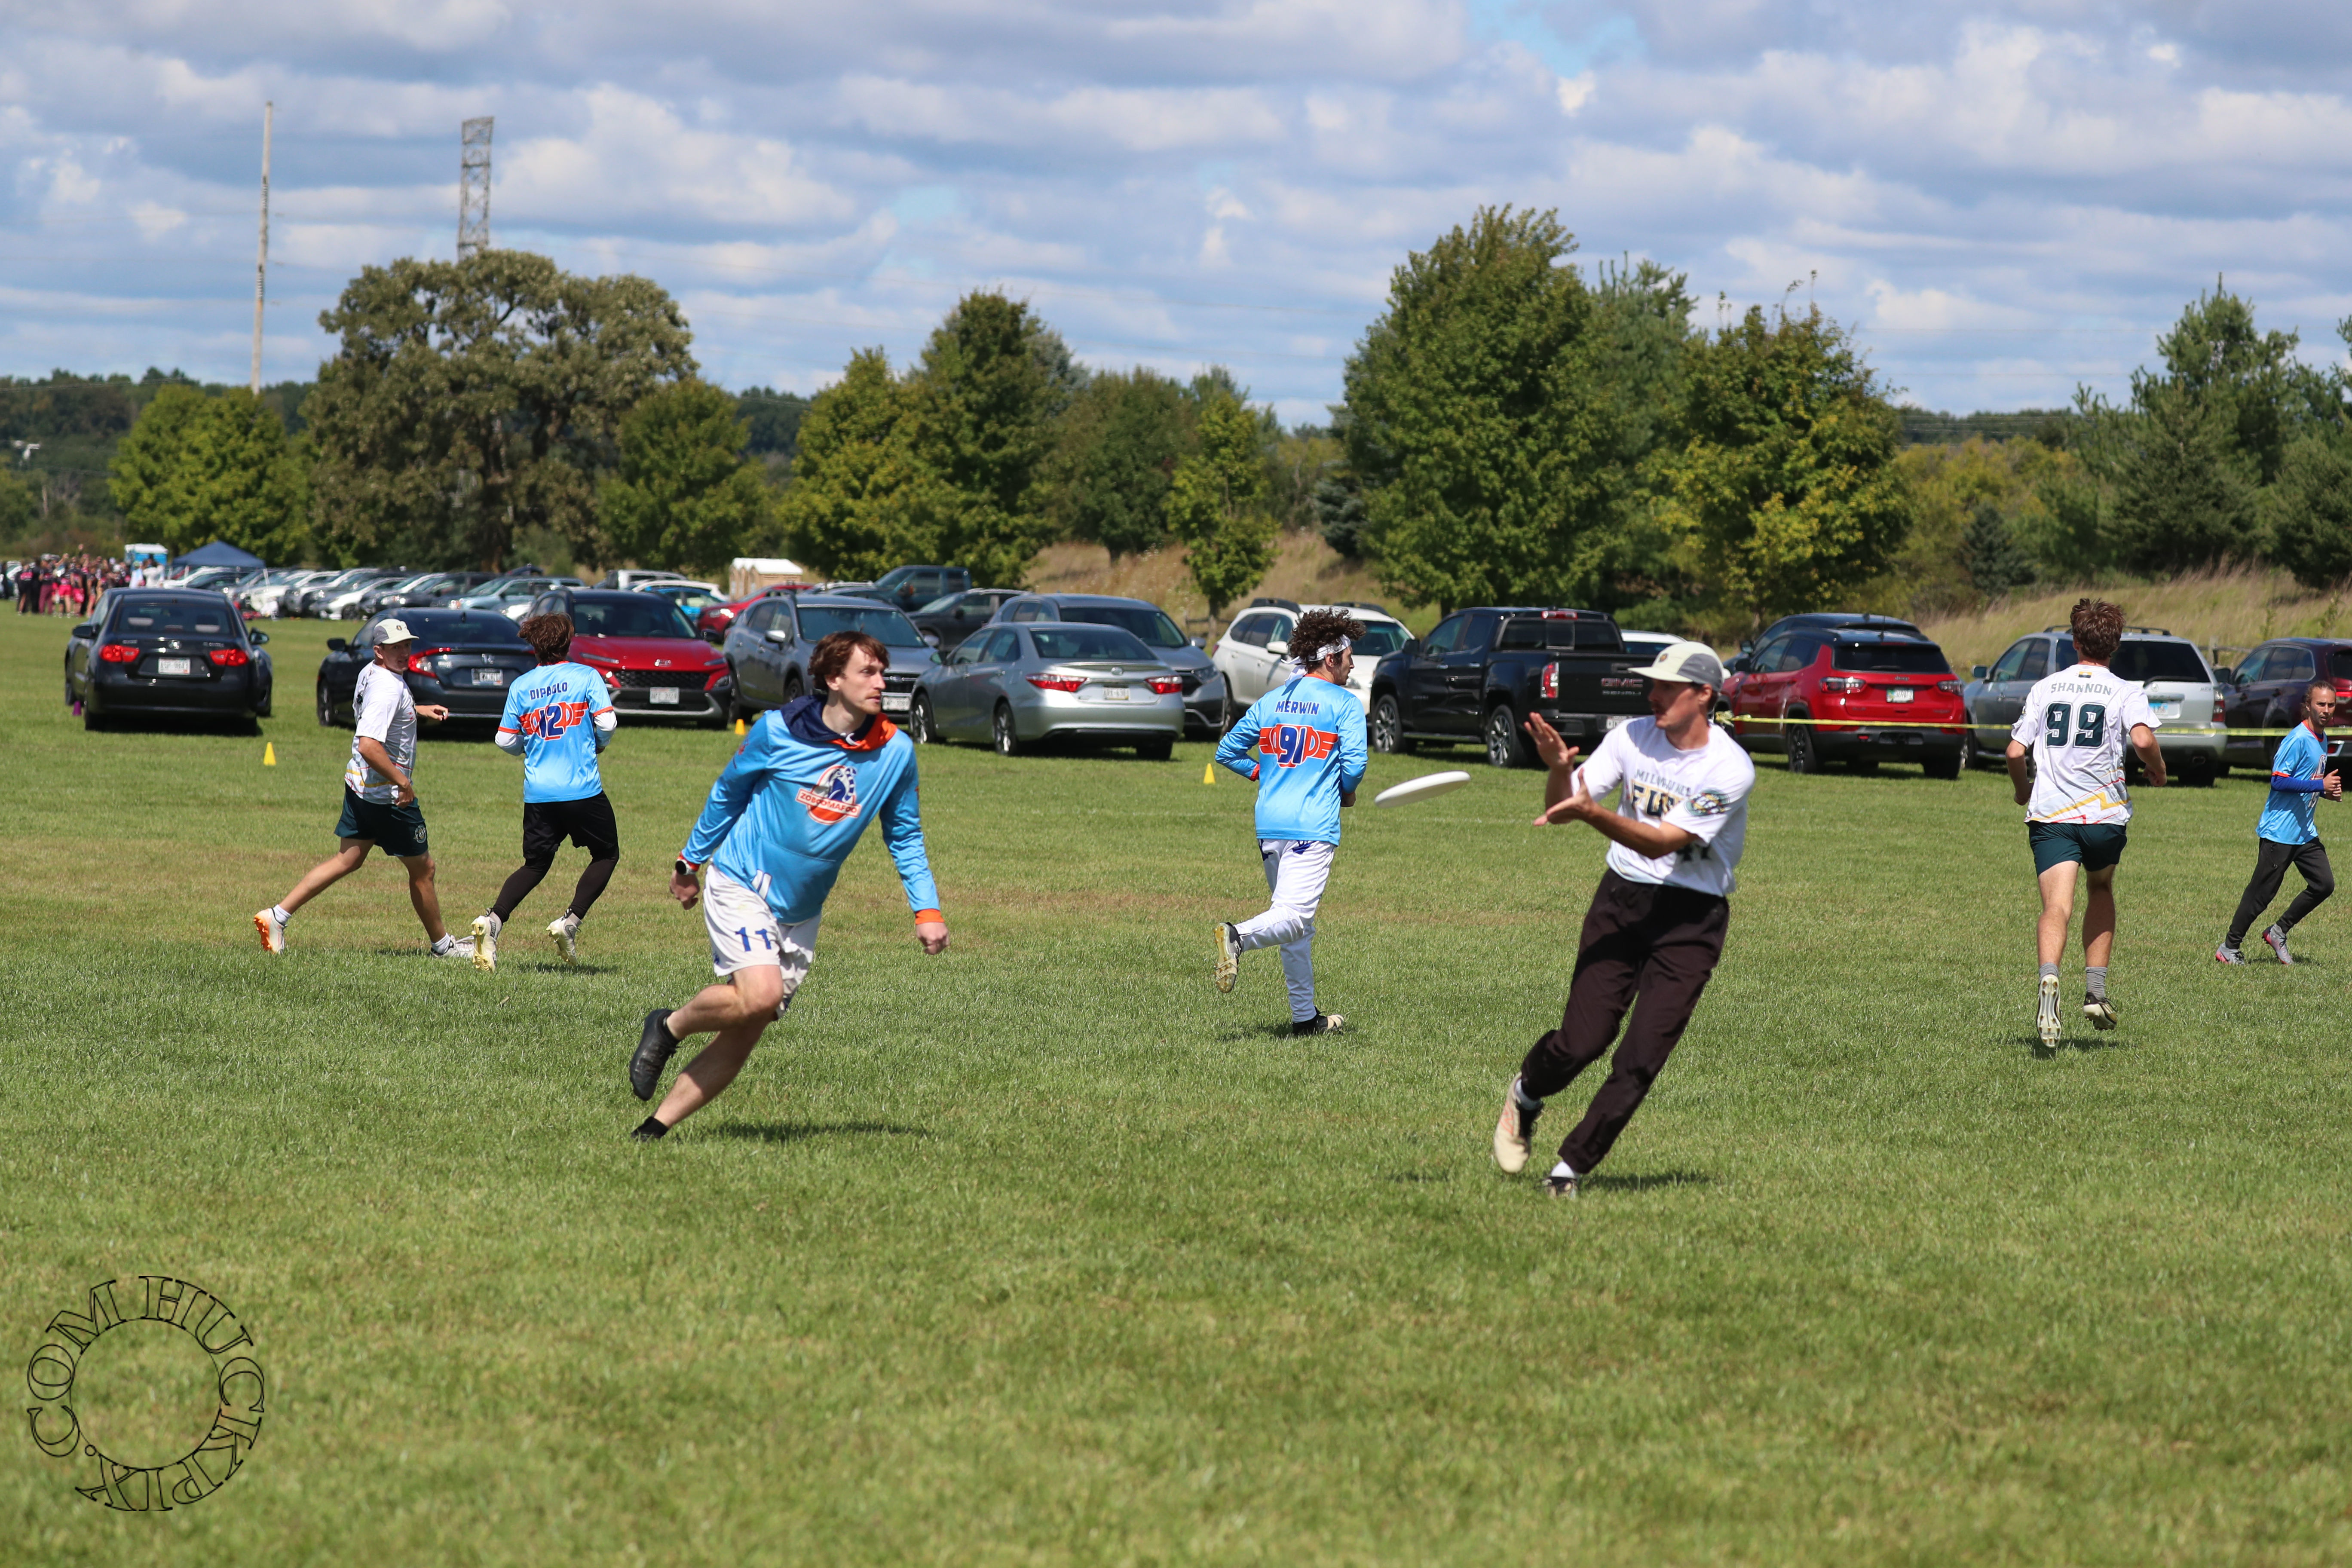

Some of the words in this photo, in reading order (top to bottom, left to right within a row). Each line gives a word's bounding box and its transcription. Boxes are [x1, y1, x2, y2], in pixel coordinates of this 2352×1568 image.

[530, 682, 568, 700] DIPAOLO
[1601, 678, 1643, 687] GMC
[2051, 683, 2112, 695] SHANNON
[1275, 701, 1320, 715] MERWIN
[539, 705, 565, 738] 12
[2045, 701, 2107, 750] 99
[1278, 726, 1307, 764] 91
[801, 793, 857, 813] ZOBOOMAFOO
[735, 927, 772, 952] 11
